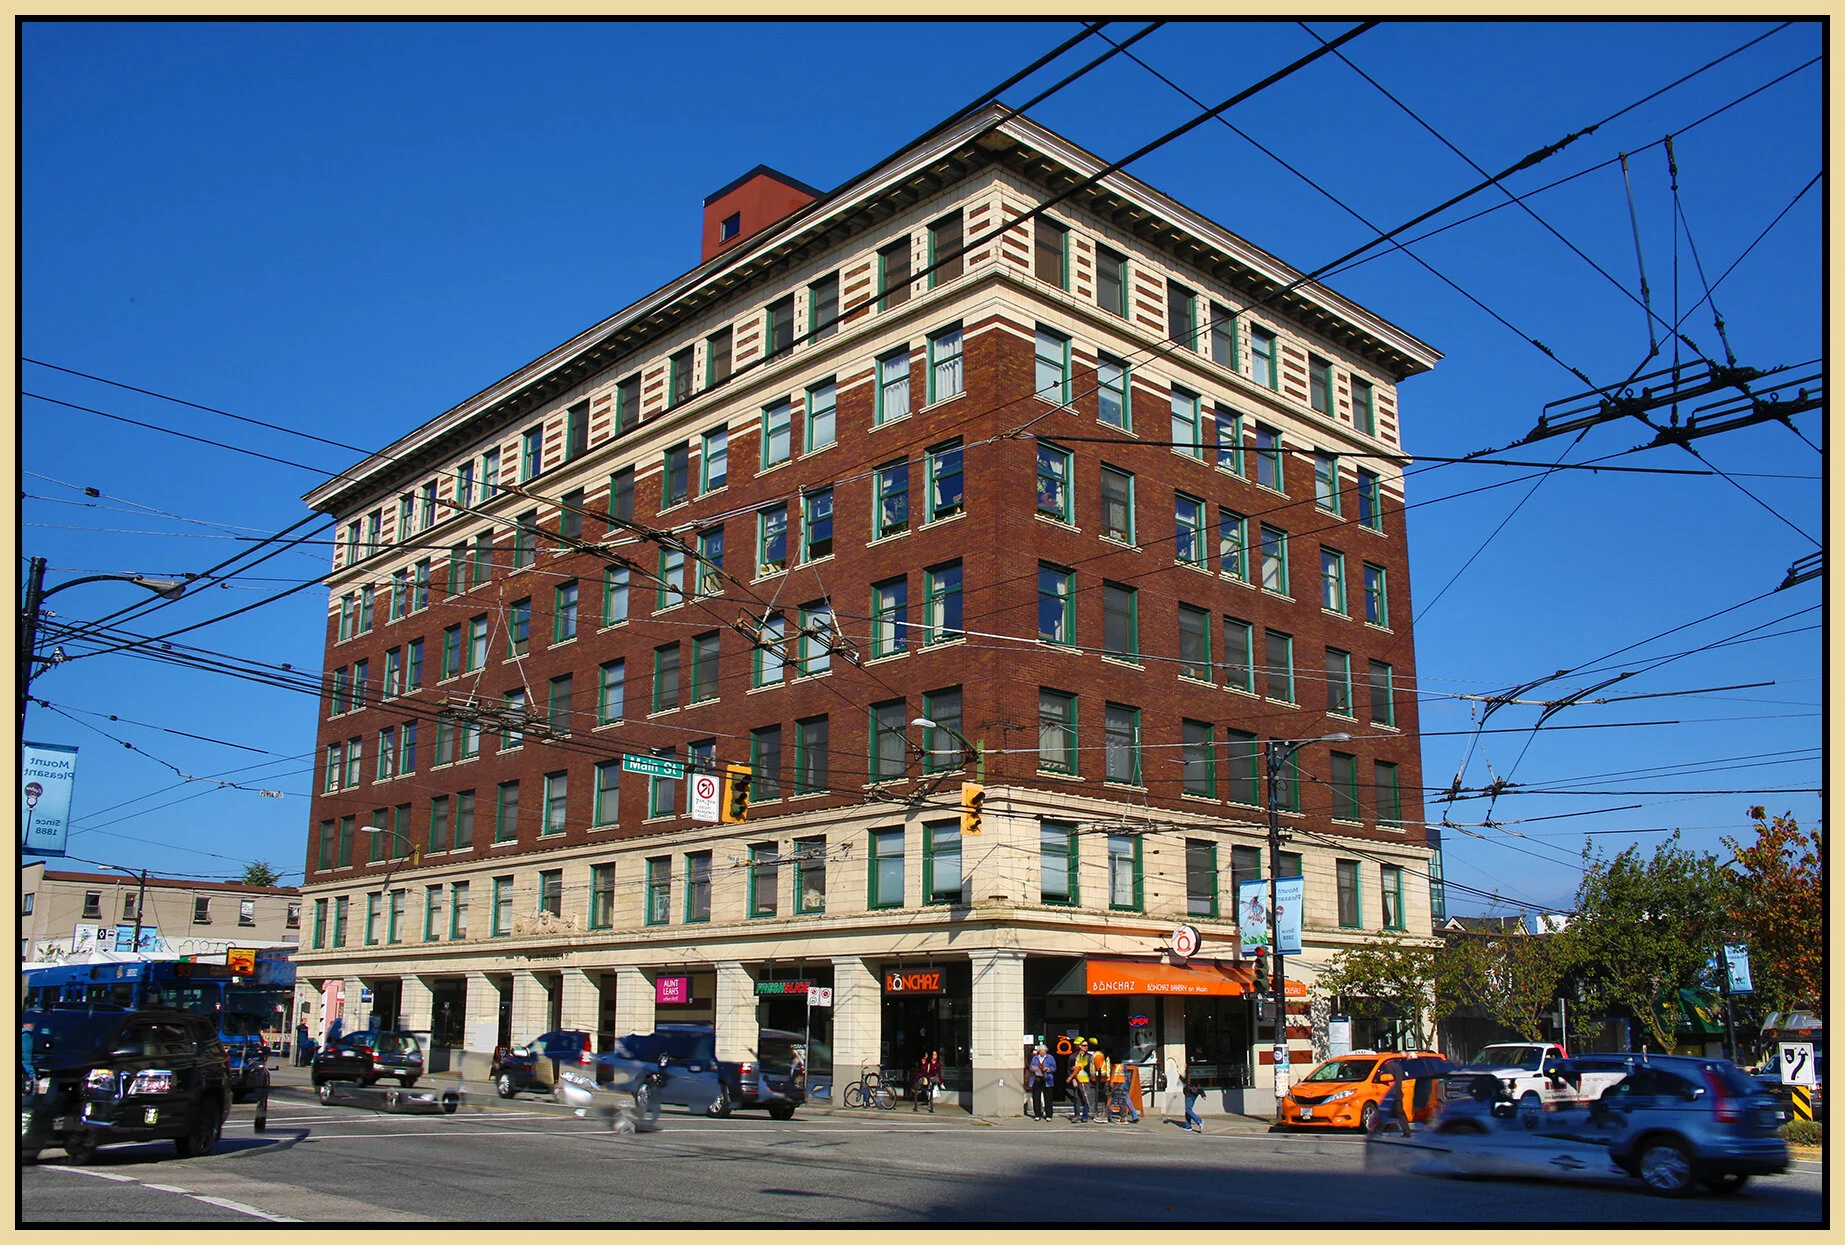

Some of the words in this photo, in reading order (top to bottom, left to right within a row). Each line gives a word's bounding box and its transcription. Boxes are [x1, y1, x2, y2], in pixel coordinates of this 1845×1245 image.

[630, 757, 659, 772] Main
[663, 761, 677, 775] St
[663, 979, 679, 987] AUNT
[1170, 984, 1187, 992] BAKERY
[1129, 1017, 1149, 1026] OPEN
